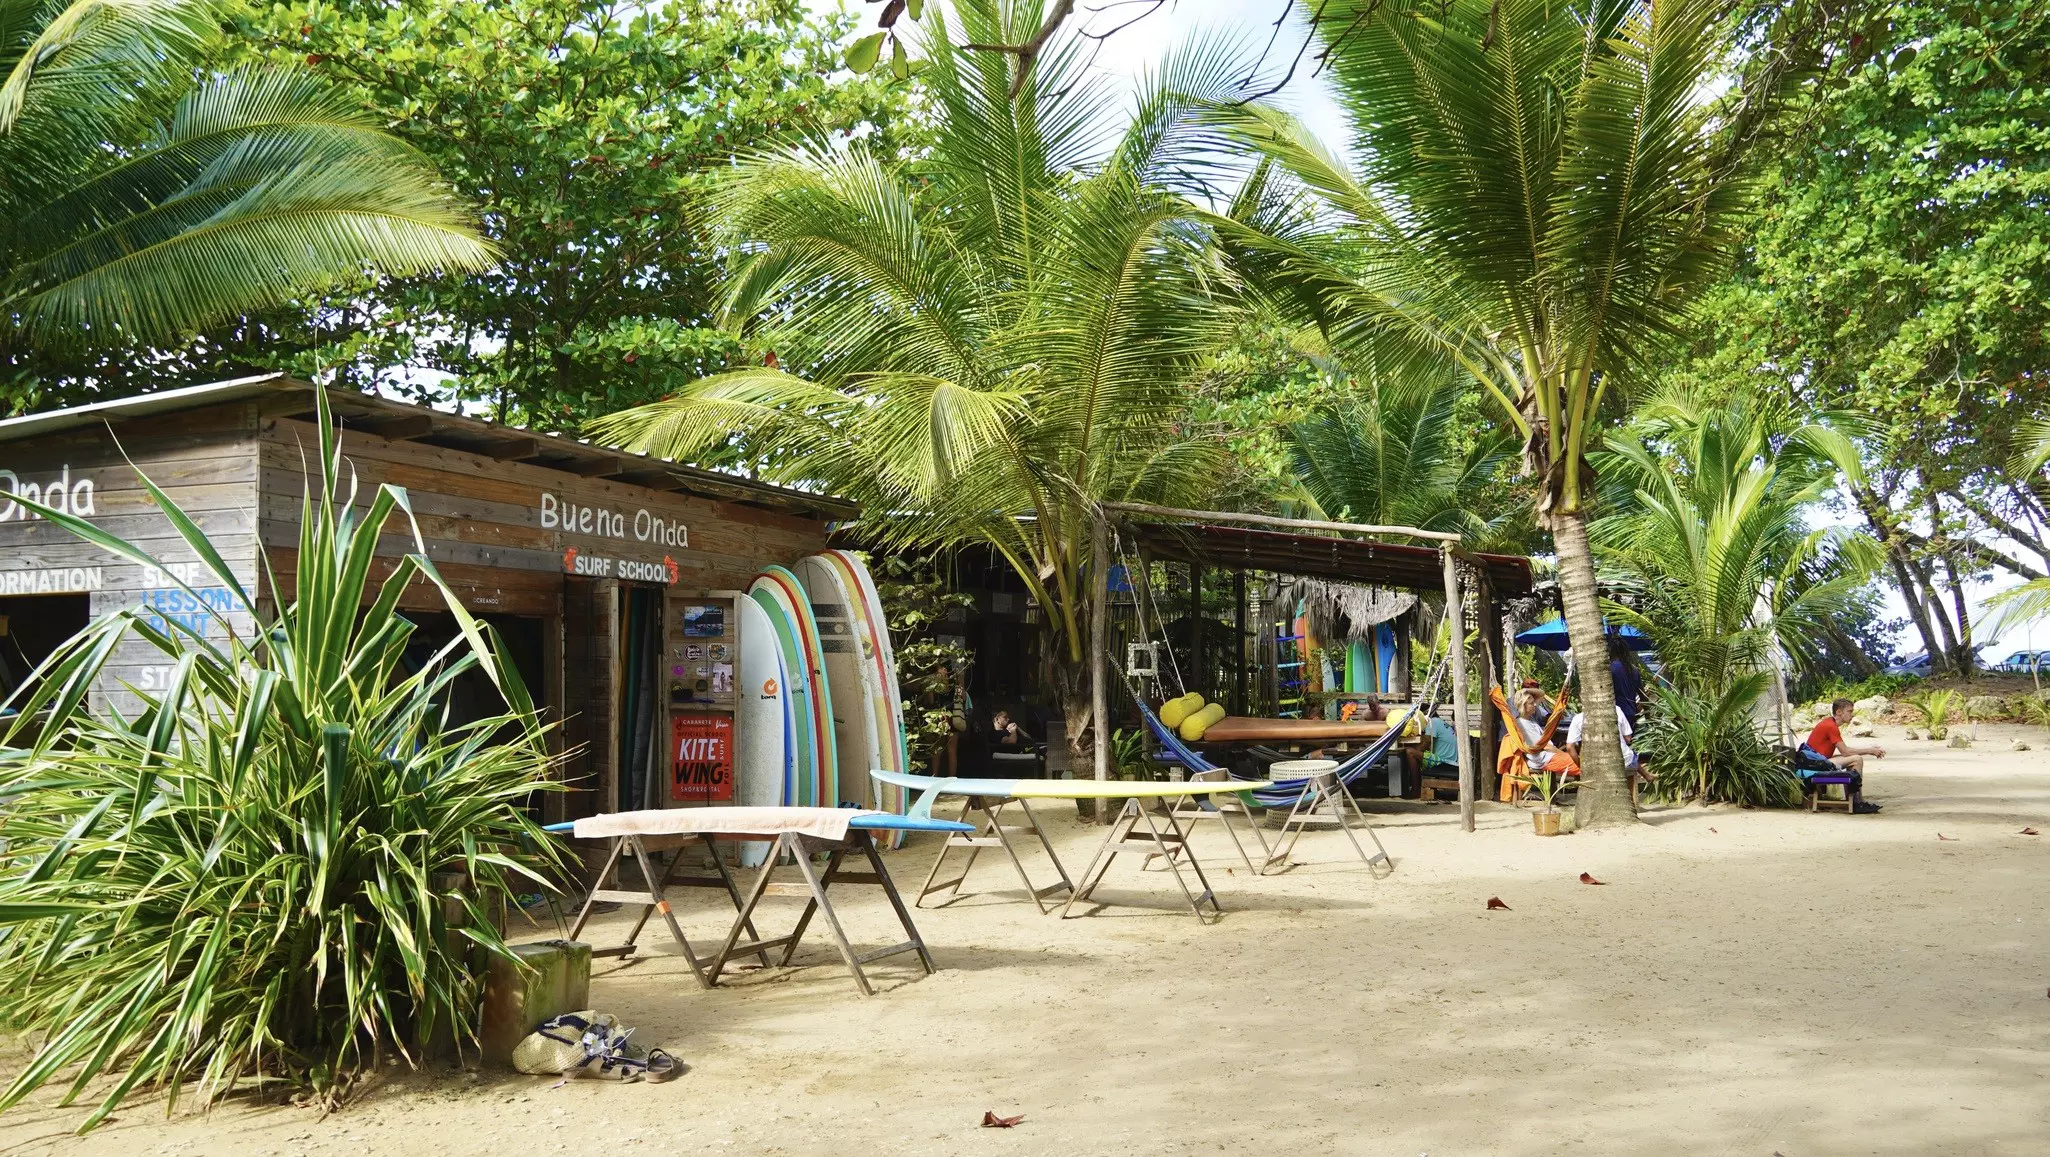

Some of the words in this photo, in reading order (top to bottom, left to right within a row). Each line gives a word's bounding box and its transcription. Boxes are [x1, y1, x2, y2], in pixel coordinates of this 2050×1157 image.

[0, 464, 96, 522] Onda
[541, 493, 625, 538] Buena
[634, 508, 689, 548] Onda
[142, 562, 200, 588] SURF
[575, 556, 611, 576] SURF
[618, 560, 669, 583] SCHOOL
[150, 613, 211, 638] RNT
[679, 738, 719, 760] KITE
[675, 762, 724, 785] WING
